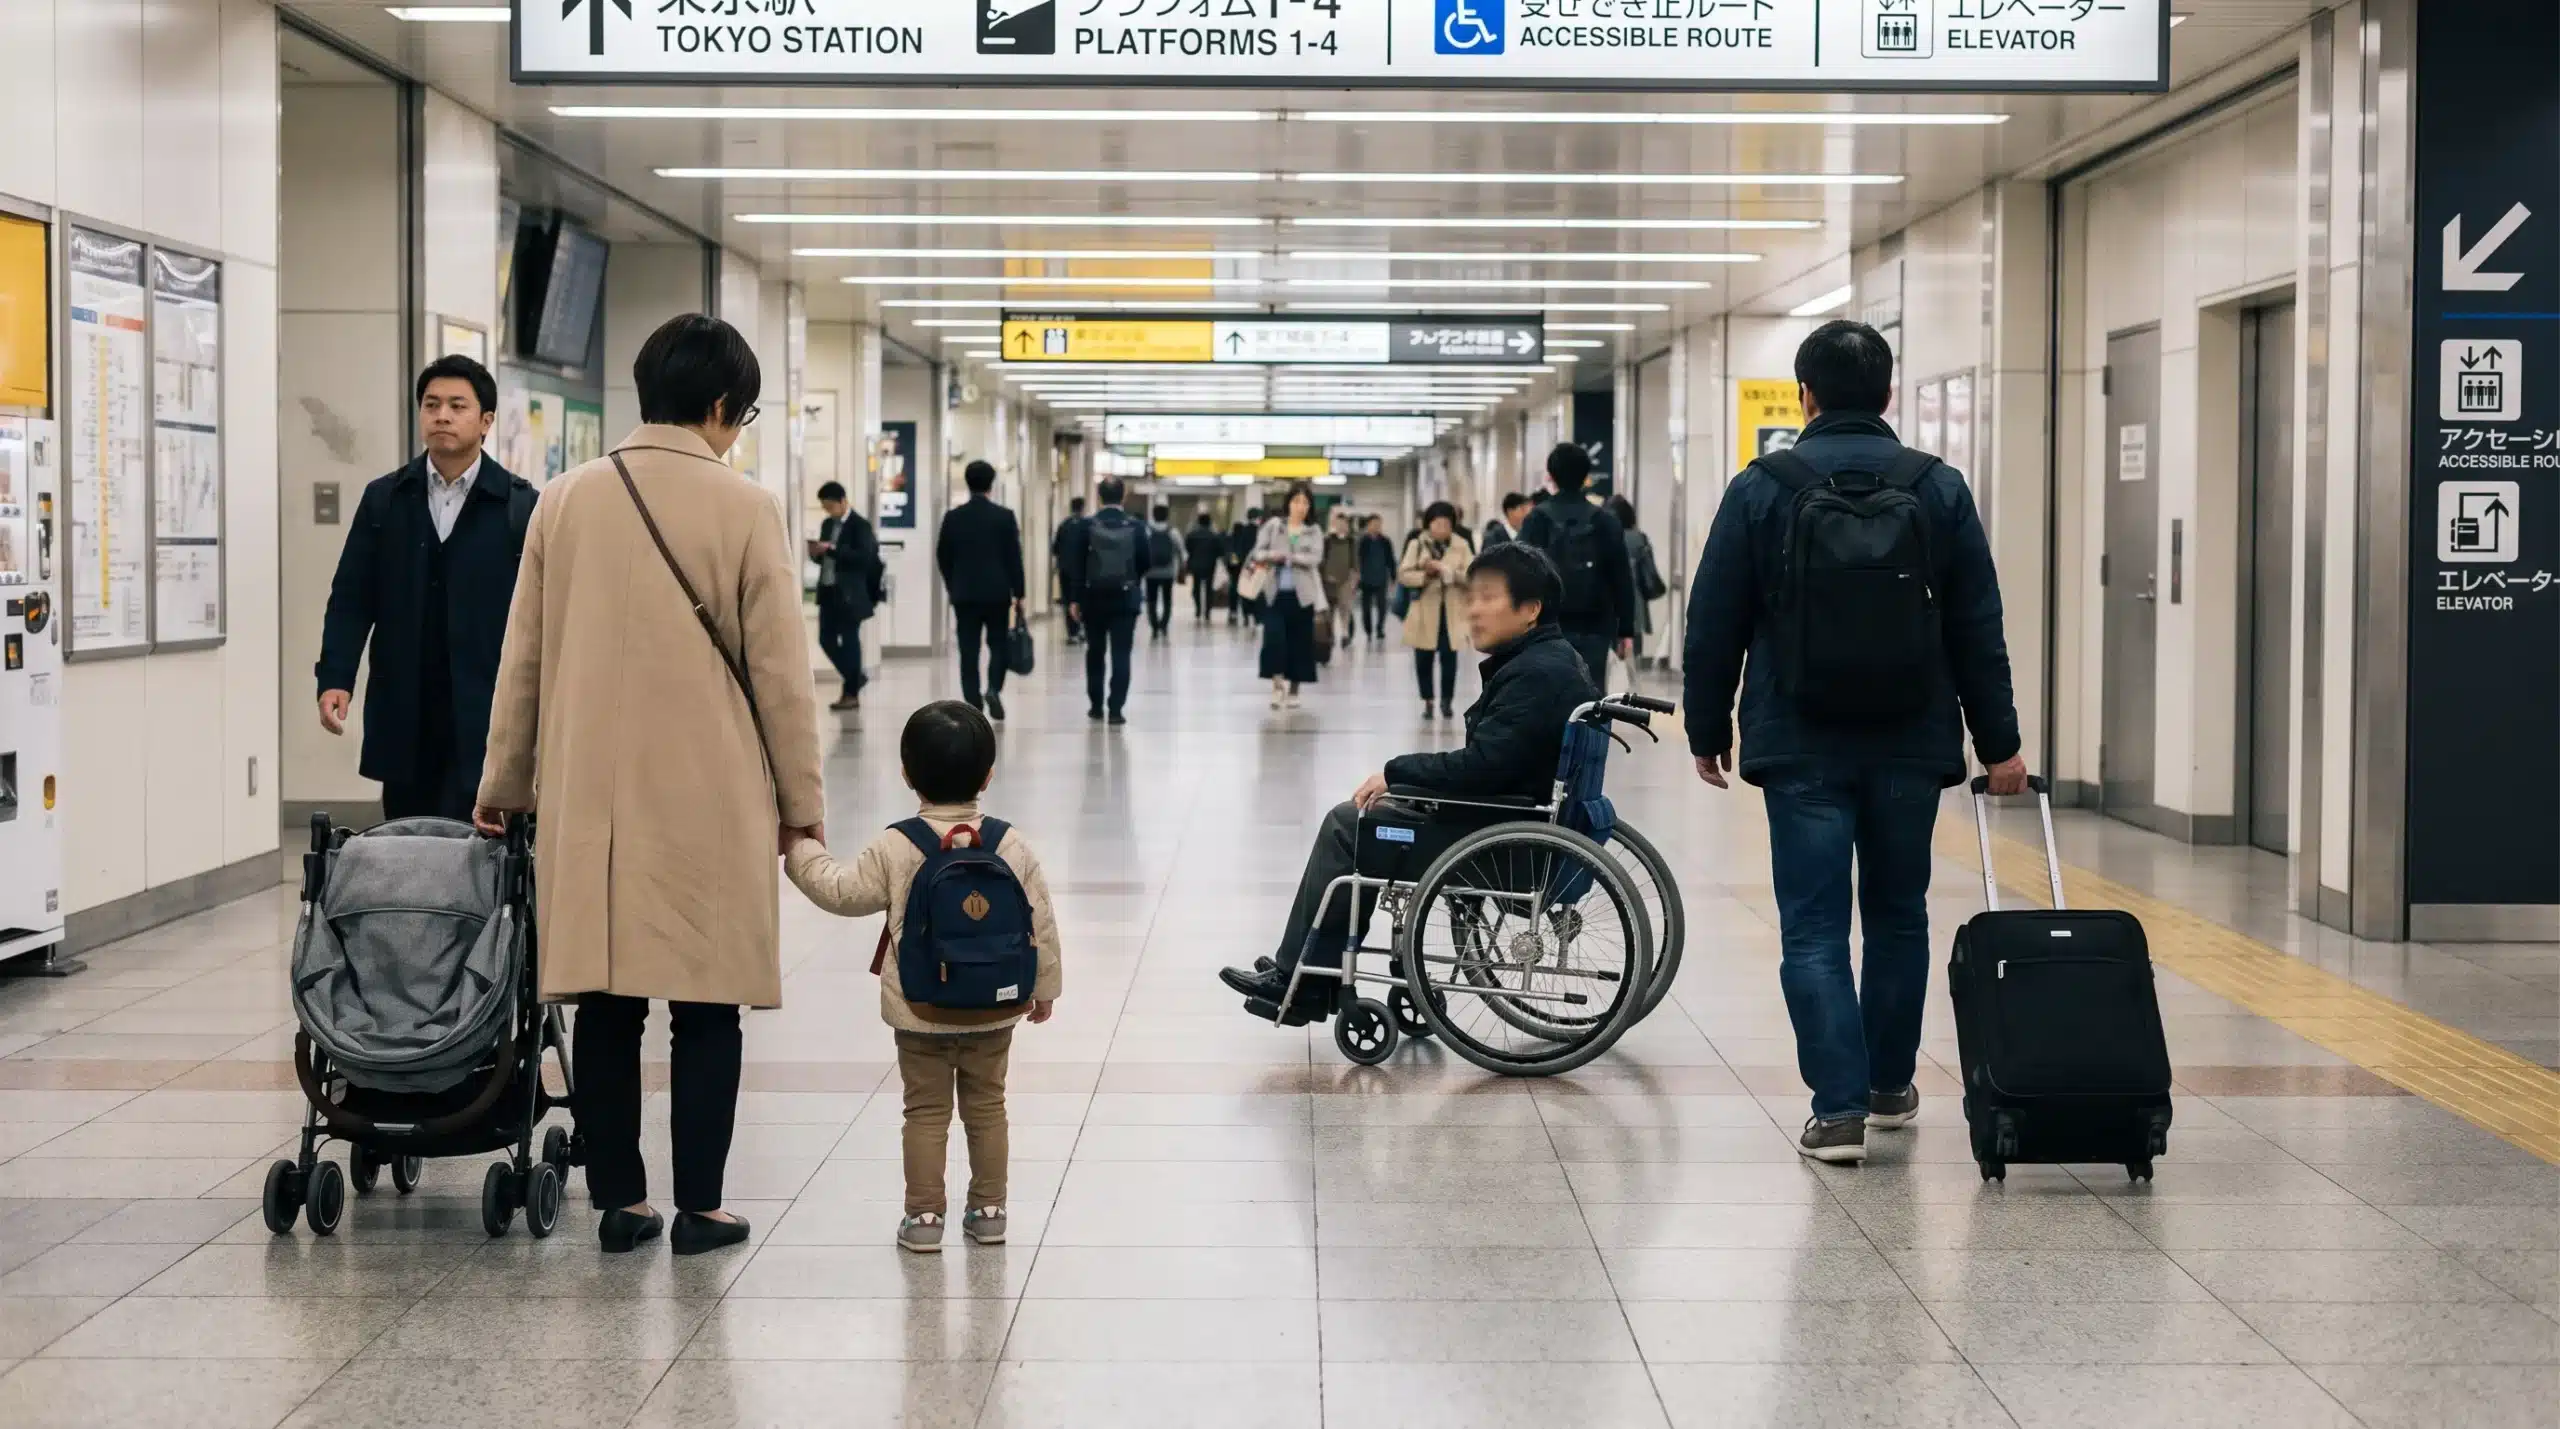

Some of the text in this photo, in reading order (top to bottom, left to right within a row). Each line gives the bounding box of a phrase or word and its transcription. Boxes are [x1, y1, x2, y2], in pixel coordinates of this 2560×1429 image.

[656, 25, 922, 54] TOKYO STATION
[1075, 28, 1338, 56] PLATFORMS 1-4
[1520, 26, 1772, 48] ACCESSIBLE ROUTE
[1948, 29, 2076, 50] ELEVATOR
[2439, 428, 2560, 450] アクセーシ
[2438, 455, 2530, 468] ACCESSIBLE
[2436, 596, 2513, 610] ELEVATOR
